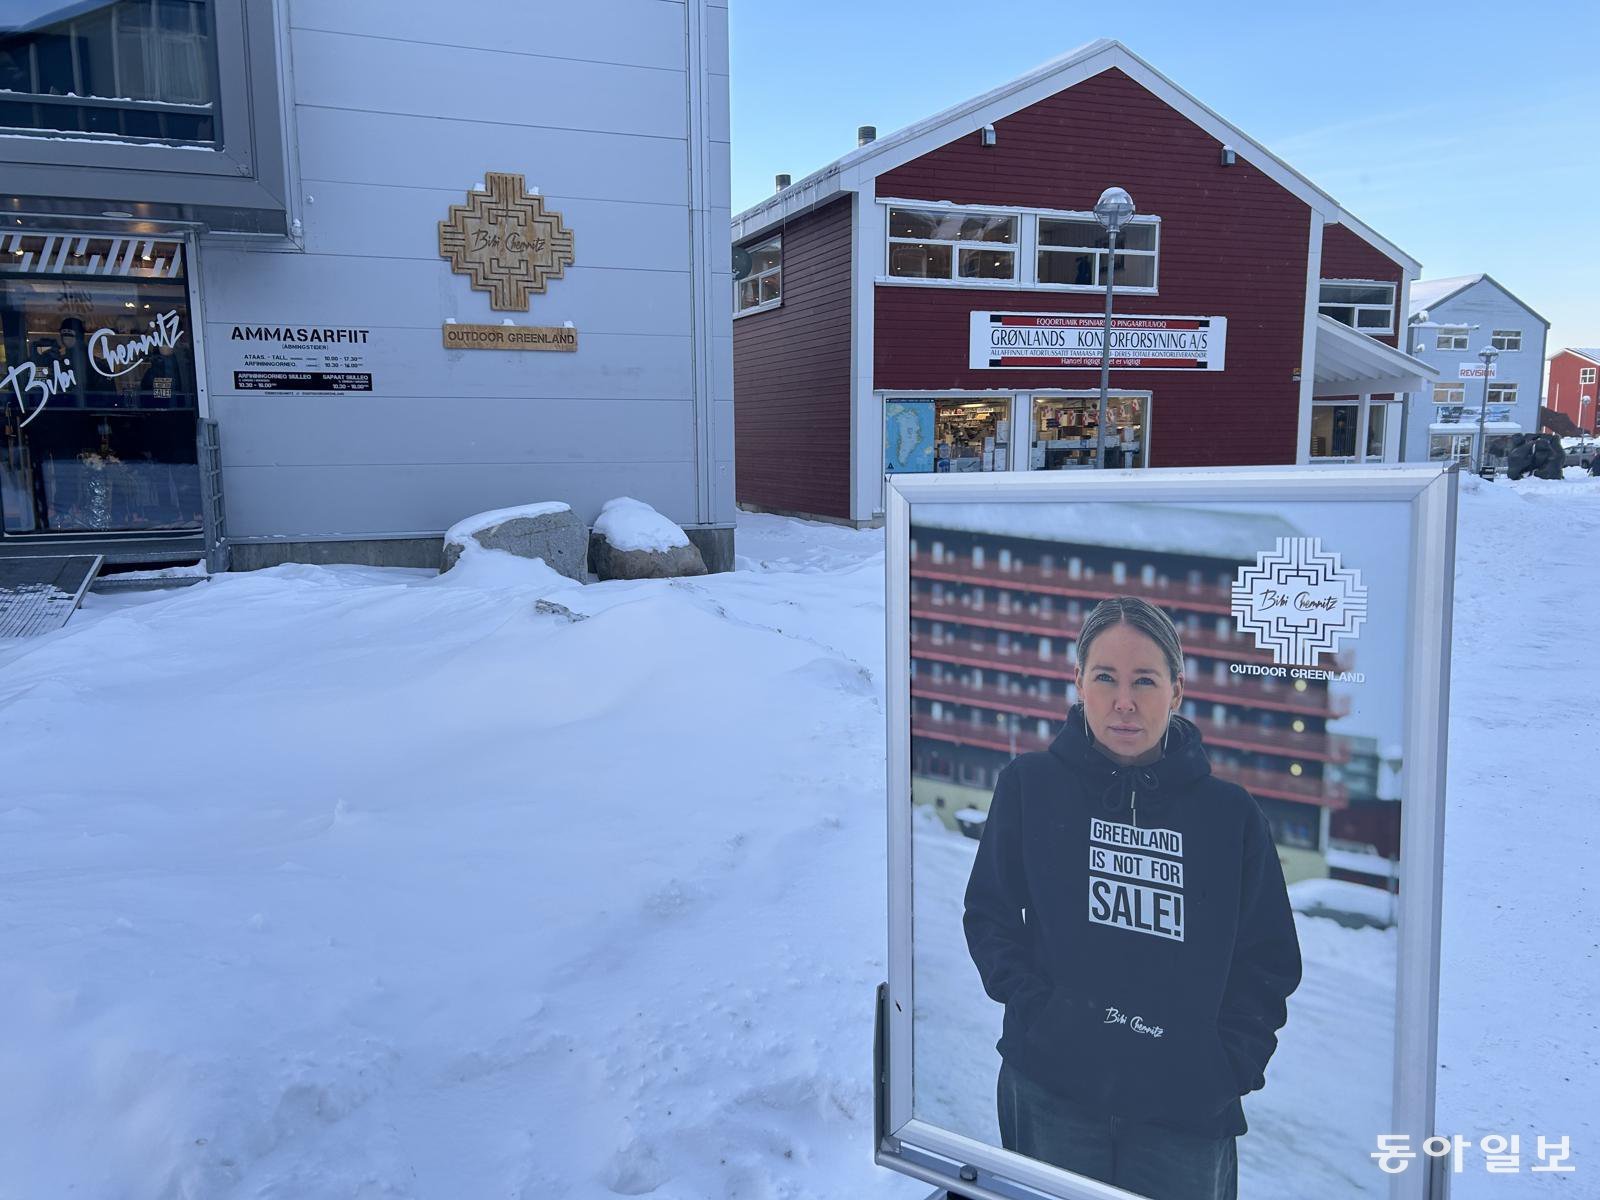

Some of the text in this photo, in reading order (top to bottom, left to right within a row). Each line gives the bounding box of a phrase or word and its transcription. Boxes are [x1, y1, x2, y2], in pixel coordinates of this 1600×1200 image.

[471, 229, 546, 253] Bibi Chemnitz
[231, 326, 369, 344] AMMASARFIIT
[447, 331, 575, 344] OUTDOOR GREENLAND
[991, 329, 1065, 347] GRØNLANDS
[1189, 333, 1208, 350] A/S
[0, 309, 185, 428] Bibi Chemnitz
[1257, 588, 1338, 612] Bibi Chemnitz
[1230, 664, 1365, 683] OUTDOOR GREENLAND
[1093, 821, 1180, 853] GREENLAND
[1092, 849, 1181, 884] IS NOT FOR
[1092, 880, 1181, 937] SALE!
[1104, 1007, 1127, 1024] Bibi
